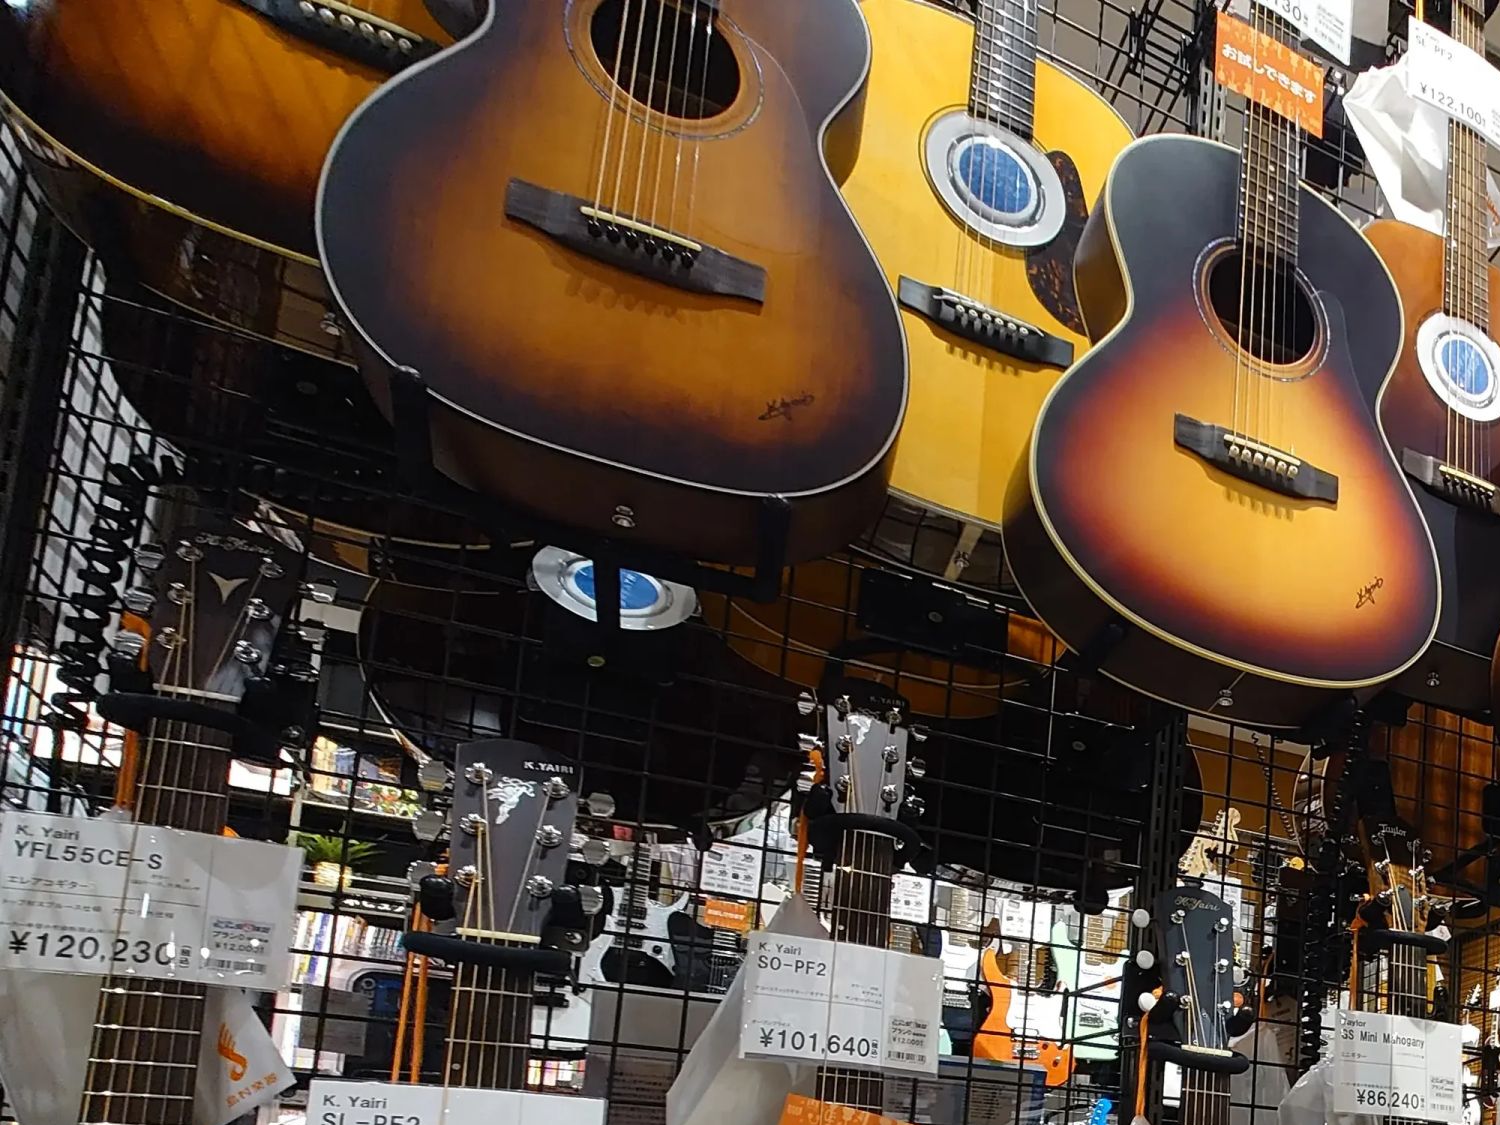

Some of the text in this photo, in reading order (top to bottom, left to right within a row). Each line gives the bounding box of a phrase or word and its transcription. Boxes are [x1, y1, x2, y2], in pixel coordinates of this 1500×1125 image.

[1221, 43, 1317, 104] お試しできます
[1420, 81, 1482, 125] ¥122,100
[15, 824, 81, 842] K. Yairi
[14, 839, 164, 871] YFL55CE-S
[8, 930, 175, 966] ¥120,230
[758, 942, 802, 956] K. Yairi
[757, 954, 828, 977] SO-PF2
[760, 1026, 871, 1058] ¥101,640
[1360, 1030, 1378, 1044] Mini
[1382, 1032, 1425, 1050] Mahogany
[322, 1094, 387, 1110] K. Yairi
[1356, 1088, 1420, 1110] ¥86,240
